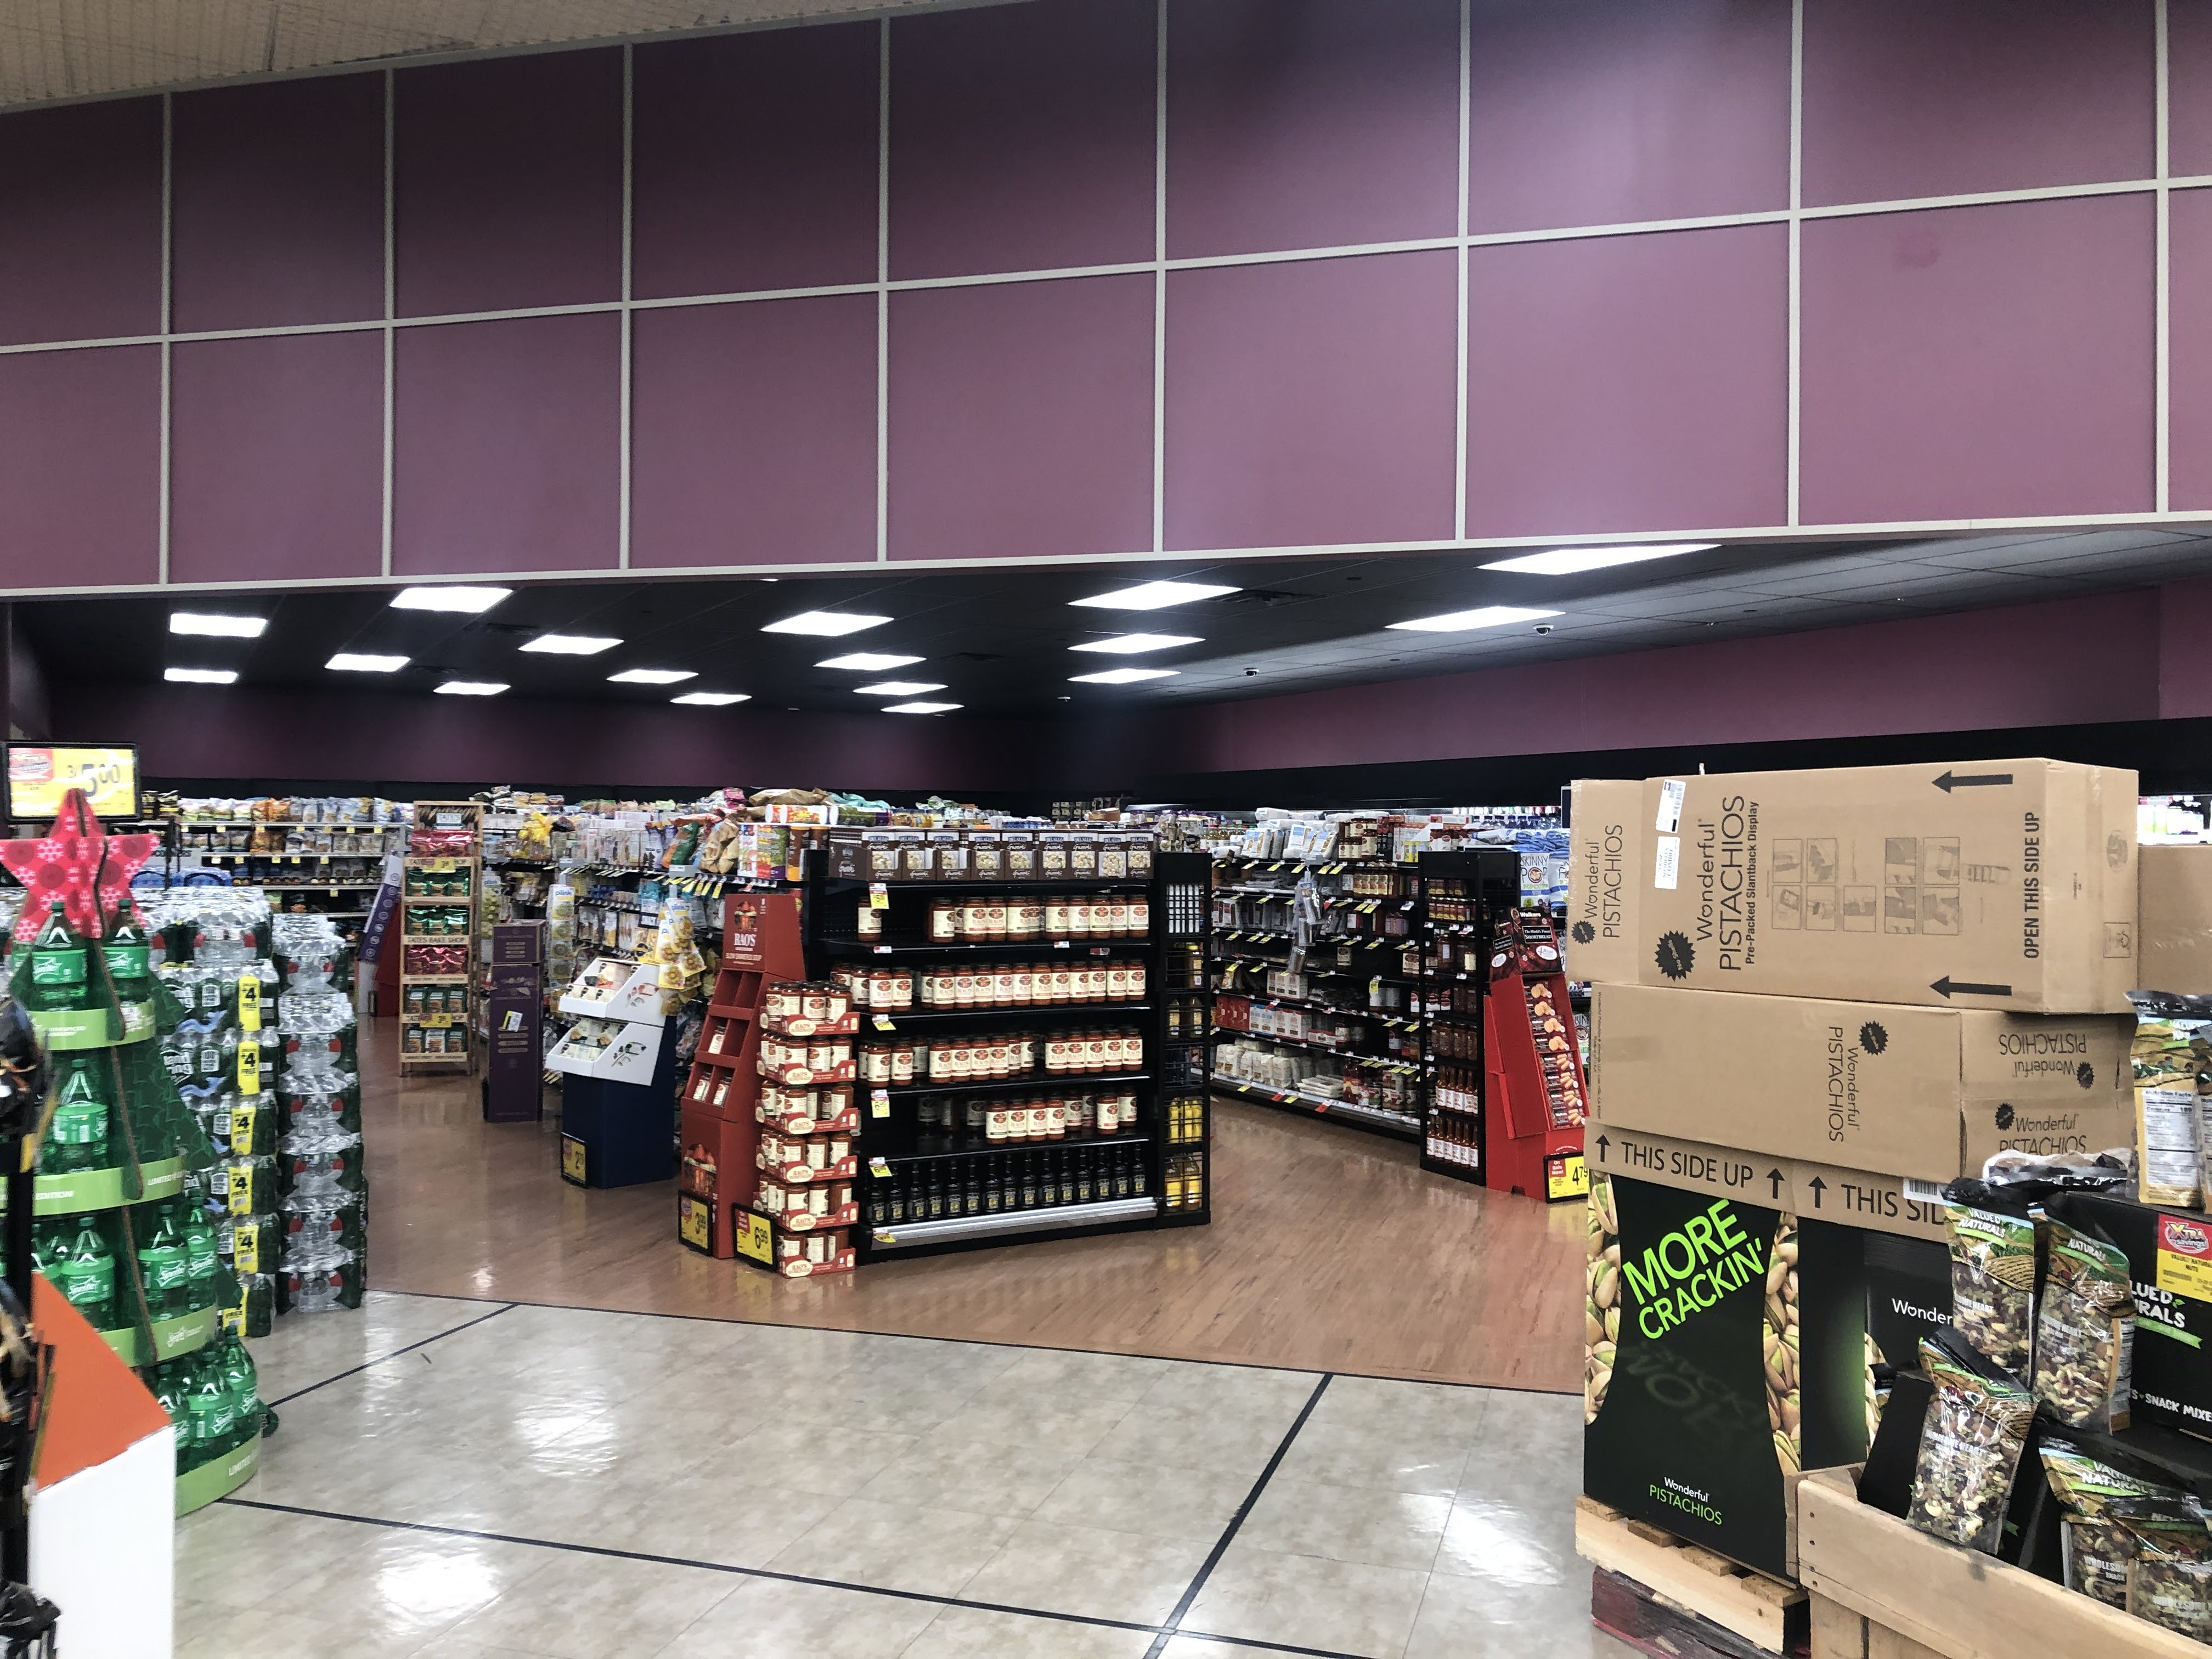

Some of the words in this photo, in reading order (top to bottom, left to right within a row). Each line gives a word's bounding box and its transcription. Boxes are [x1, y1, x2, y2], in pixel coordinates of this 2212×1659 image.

[1747, 802, 1759, 841] Display
[2024, 812, 2040, 832] UP
[1520, 855, 1548, 866] SKINNY
[1746, 844, 1757, 899] Slantback
[2024, 837, 2040, 873] SIDE
[1584, 842, 1599, 919] Wonderful
[1602, 825, 1623, 939] PISTACHIOS
[1696, 823, 1716, 941] Wonderful
[1719, 795, 1745, 971] PISTACHIOS
[2024, 877, 2039, 912] THIS
[1745, 901, 1756, 964] Pre-Packed
[2024, 918, 2039, 959] OPEN
[1999, 1033, 2087, 1055] PISTACHIOS
[1828, 1026, 1844, 1142] PISTACHIOS
[1847, 1047, 1860, 1127] Wonderful
[2014, 1060, 2076, 1078] Wonderful
[2016, 1114, 2077, 1132] Wonderful
[1621, 1141, 1665, 1172] THIS
[1671, 1152, 1717, 1182] SIDE
[1723, 1163, 1754, 1189] UP
[1999, 1135, 2087, 1156] PISTACHIOS
[1841, 1184, 1899, 1217] THIS
[1968, 1207, 2001, 1224] VALUED
[1958, 1218, 2006, 1238] NATURALS
[1622, 1199, 1750, 1306] MORE
[1638, 1237, 1765, 1340] CRACKIN'
[2145, 1393, 2180, 1413] SNACK
[1650, 1484, 1722, 1525] PISTACHIOS
[1664, 1476, 1708, 1503] Wonderful
